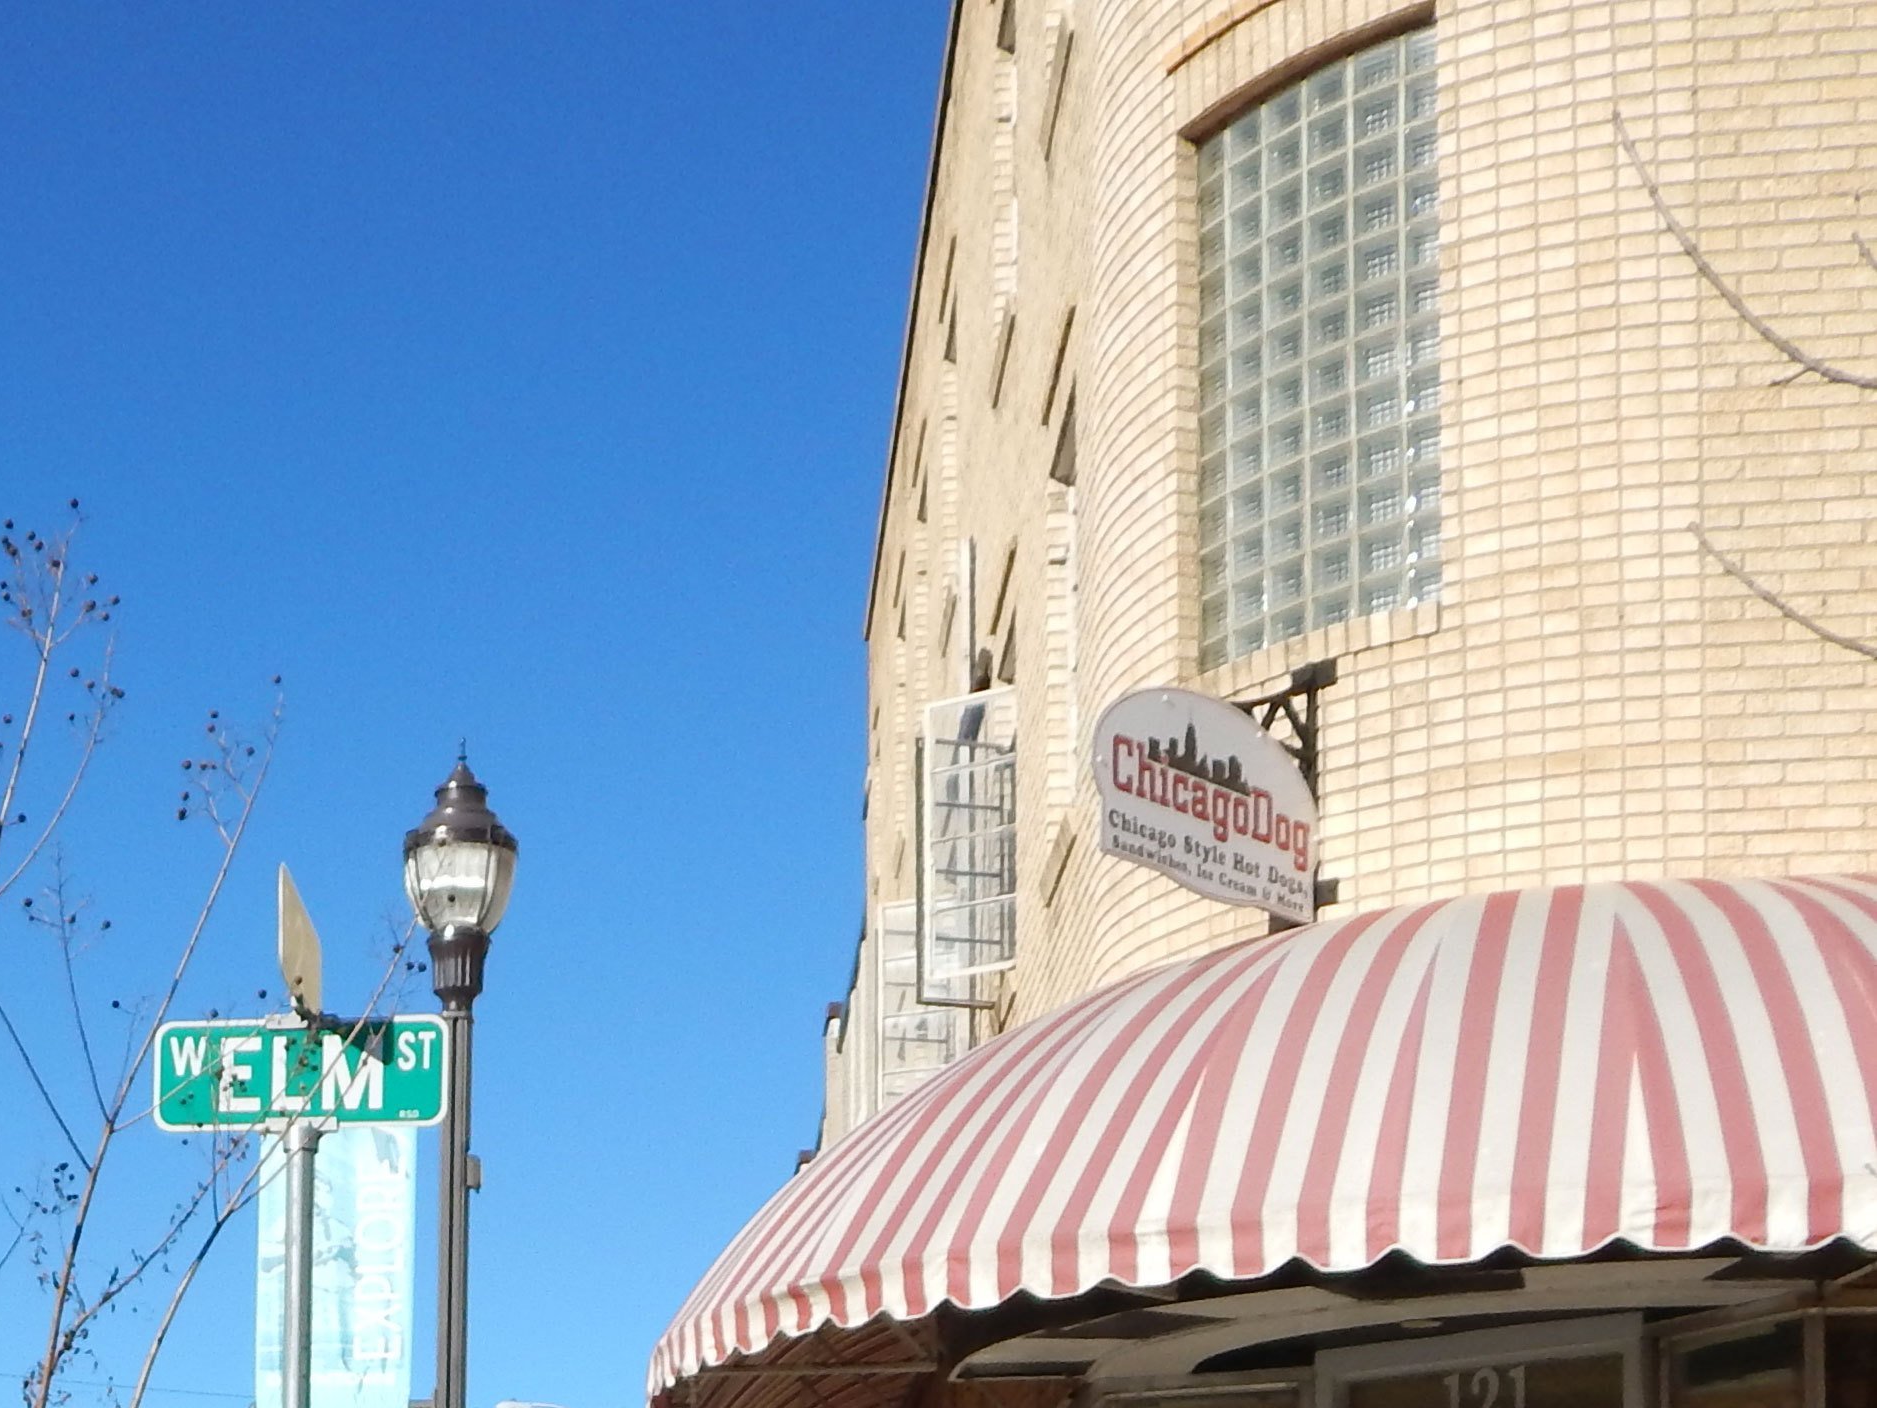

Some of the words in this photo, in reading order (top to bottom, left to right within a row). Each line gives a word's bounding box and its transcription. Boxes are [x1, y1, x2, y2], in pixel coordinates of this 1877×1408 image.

[1108, 808, 1176, 849] Chicago
[1184, 835, 1226, 865] Style
[1233, 852, 1260, 878] Hot
[1267, 866, 1308, 899] Dogs,
[1112, 834, 1192, 877] Sandwiches,
[1197, 864, 1213, 880] Ice
[1218, 872, 1257, 896] Cream
[1277, 892, 1304, 912] More
[170, 1036, 207, 1076] W
[218, 1034, 384, 1113] ELM
[397, 1031, 437, 1072] ST
